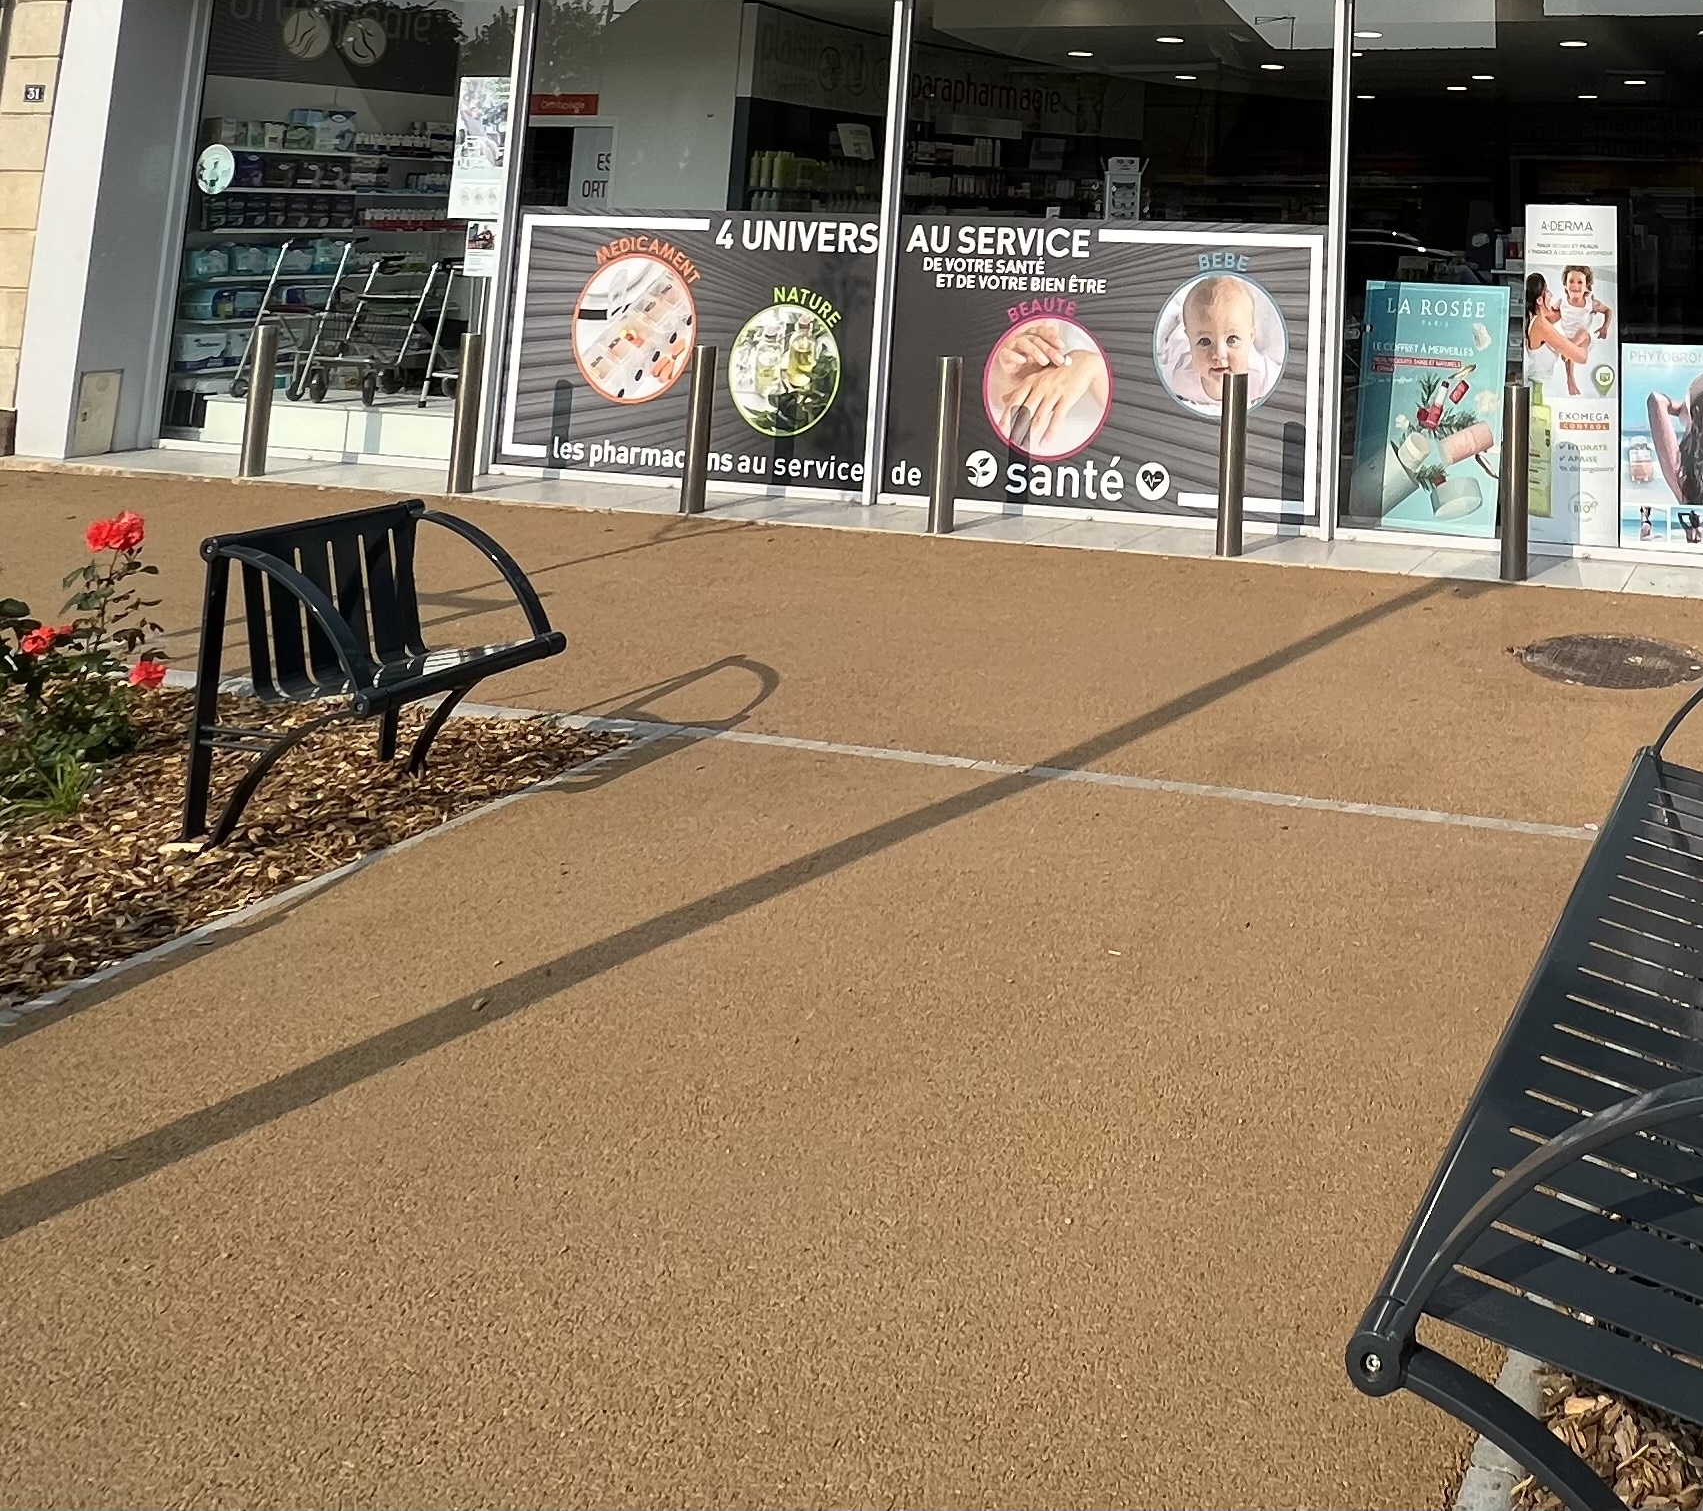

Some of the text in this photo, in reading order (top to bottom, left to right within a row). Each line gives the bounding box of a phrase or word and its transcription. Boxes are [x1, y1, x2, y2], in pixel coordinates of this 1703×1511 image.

[27, 87, 40, 100] 31
[715, 219, 879, 254] 4 UNIVERS
[906, 224, 1091, 258] AU SERVICE
[923, 255, 1046, 275] DE VOTRE SANTÉ
[936, 273, 1107, 294] ET DE VOTRE BIEN ÊTRE
[773, 286, 844, 328] NATURE
[1386, 297, 1485, 318] LA ROSÉE
[1372, 342, 1382, 351] LE
[1384, 343, 1418, 353] COFFRET
[1558, 412, 1610, 421] EXOMEGA
[553, 437, 923, 486] les pharmacns au service de
[1005, 456, 1125, 502] santé
